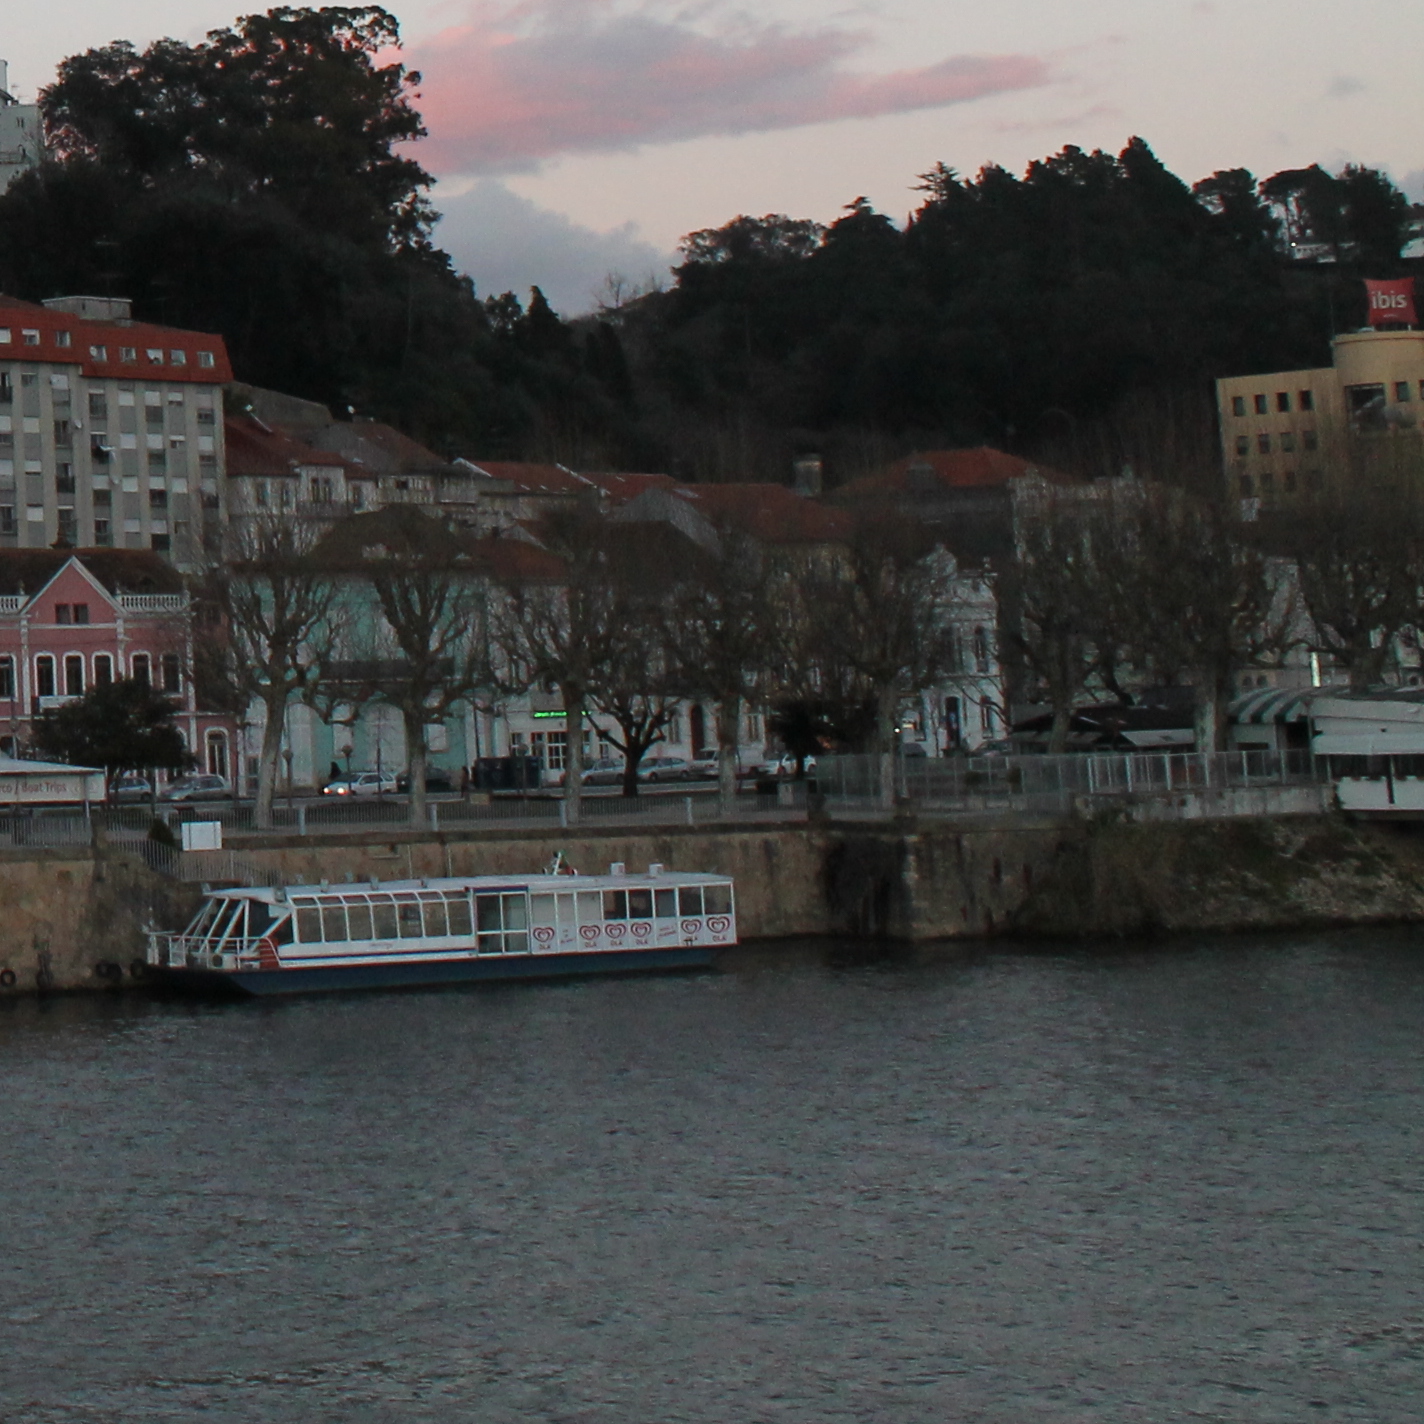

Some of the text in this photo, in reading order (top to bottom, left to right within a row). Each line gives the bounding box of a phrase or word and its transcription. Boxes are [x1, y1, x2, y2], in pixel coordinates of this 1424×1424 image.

[1371, 290, 1408, 309] ibis
[21, 782, 42, 793] Boat
[43, 781, 67, 794] Trips
